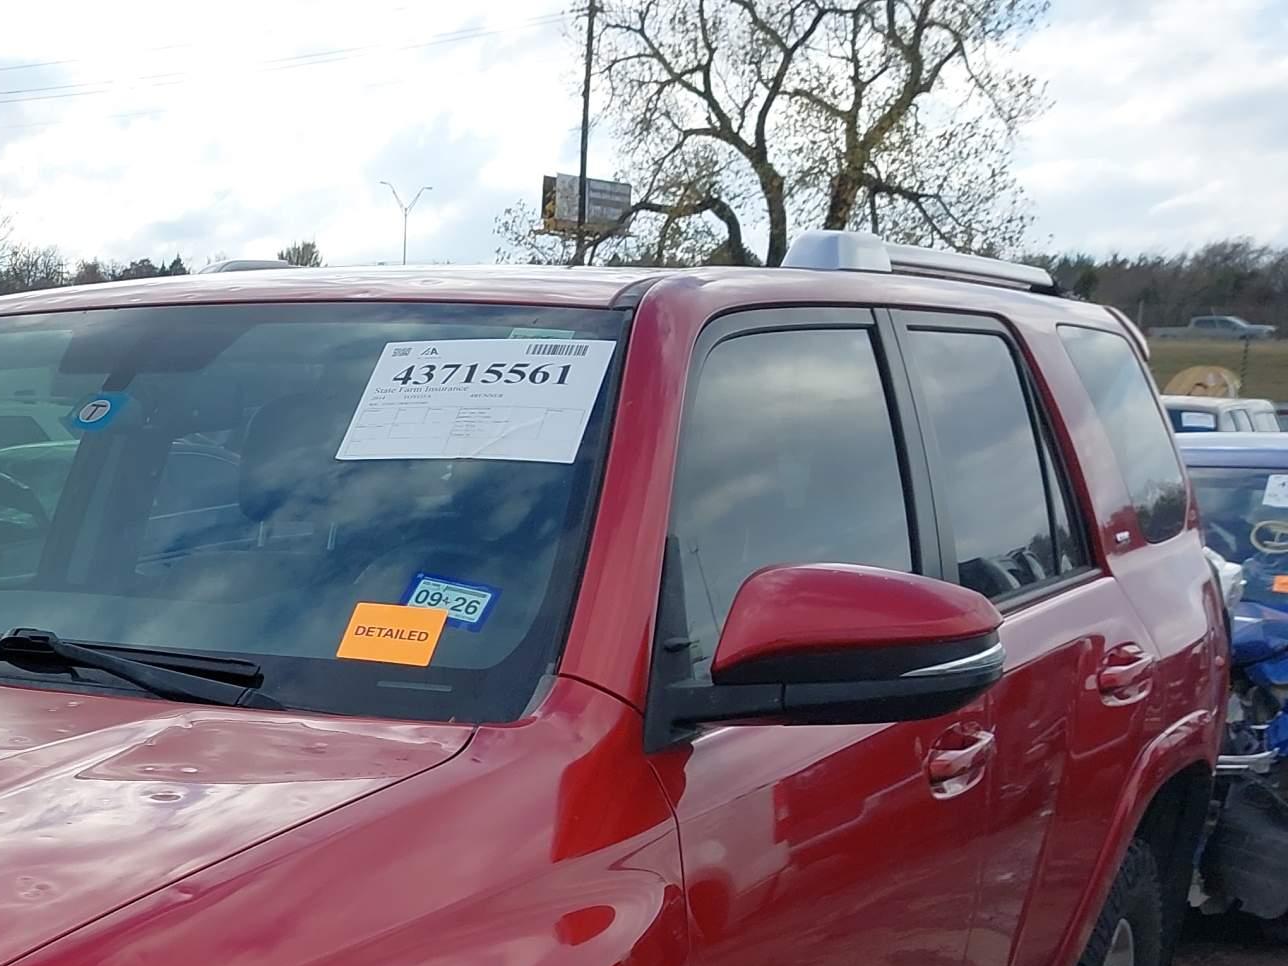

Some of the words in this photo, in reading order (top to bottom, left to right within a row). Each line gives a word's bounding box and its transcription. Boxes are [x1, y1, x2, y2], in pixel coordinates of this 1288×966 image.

[393, 363, 572, 385] 43715561
[414, 589, 443, 607] 09
[450, 596, 481, 615] 26
[354, 625, 430, 642] DETAILED
